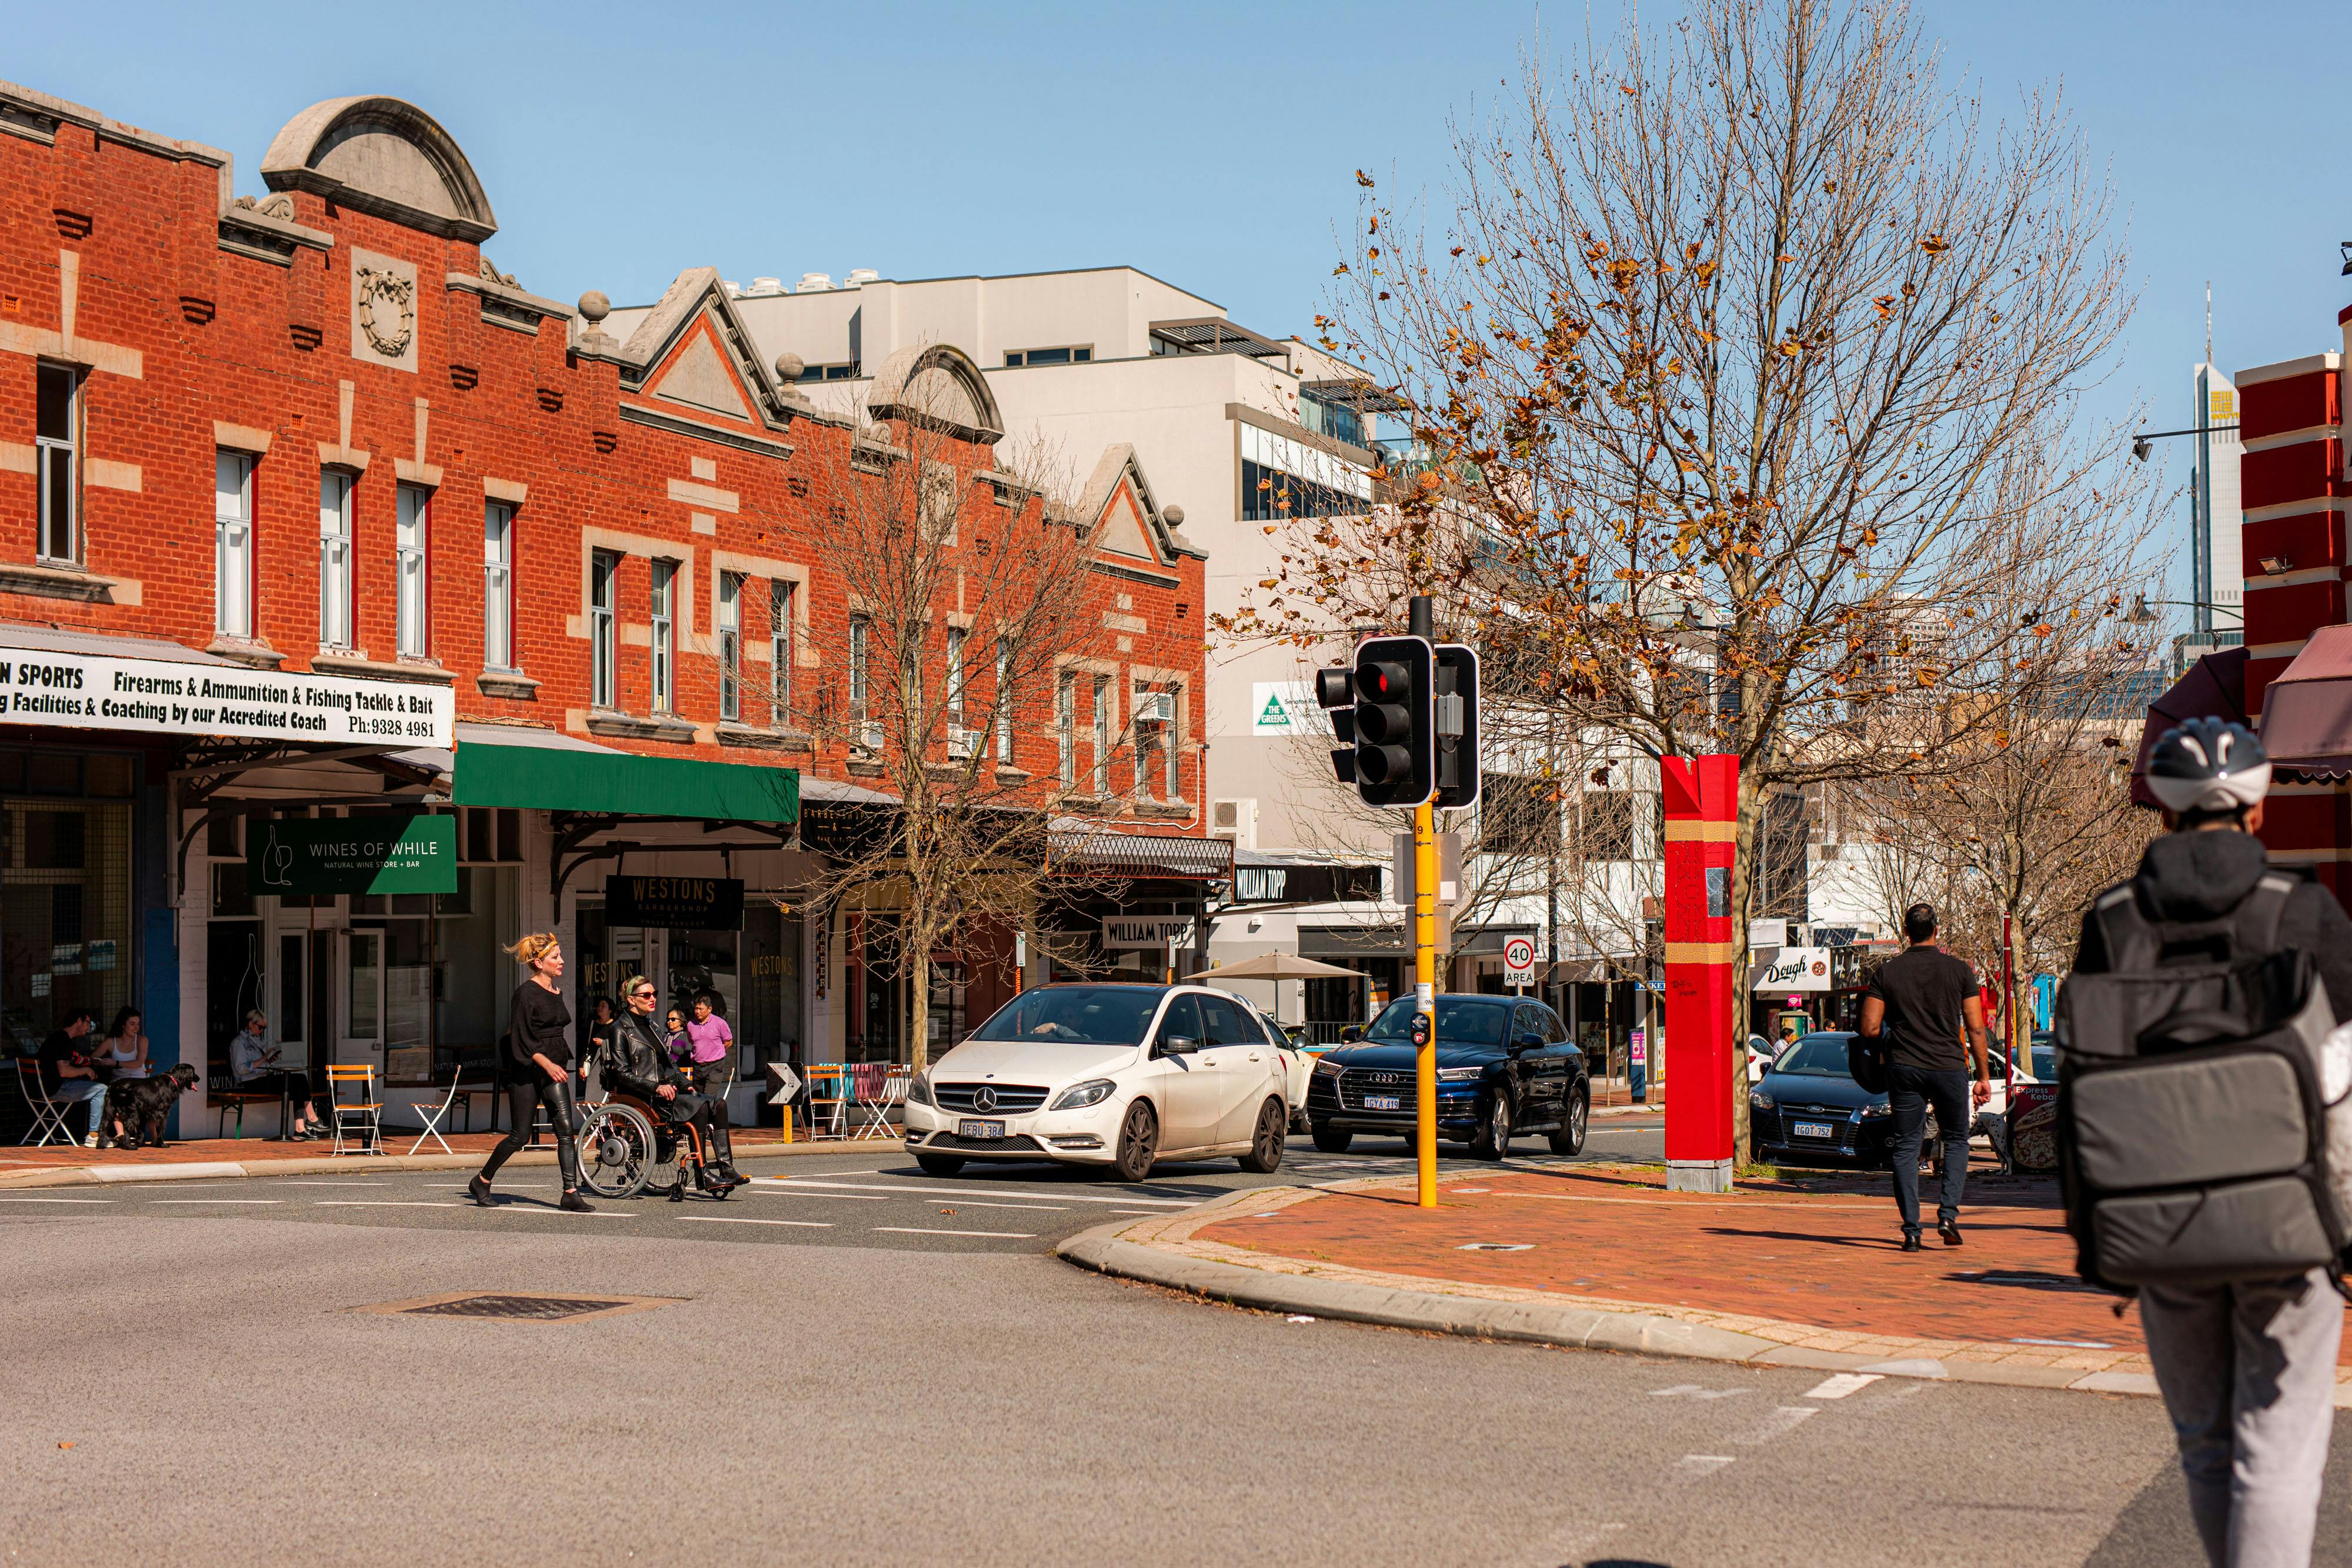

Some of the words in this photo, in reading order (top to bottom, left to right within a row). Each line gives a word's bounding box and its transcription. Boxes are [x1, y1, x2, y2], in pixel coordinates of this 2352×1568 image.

[18, 664, 83, 689] SPORTS
[114, 671, 182, 696] Firearms
[187, 677, 197, 696] &
[201, 678, 288, 704] Ammunition
[292, 686, 302, 705] &
[306, 688, 352, 712] Fishing
[355, 691, 393, 711] Tackle
[397, 695, 406, 713] &
[410, 696, 433, 714] Bait
[13, 693, 81, 714] Facilities
[85, 697, 96, 716] &
[101, 698, 167, 724] Coaching
[172, 701, 188, 724] by
[192, 707, 215, 723] our
[219, 706, 286, 728] Accredited
[290, 711, 326, 730] Coach
[1268, 706, 1280, 714] THE
[1262, 715, 1287, 724] GREENS
[406, 721, 435, 737] 4981
[833, 823, 837, 831] &
[1418, 825, 1423, 834] 9
[310, 844, 358, 857] WINES
[364, 842, 384, 856] OF
[390, 842, 437, 855] WHILE
[633, 878, 716, 903] WESTONS
[1237, 869, 1266, 900] WILLIAM
[1267, 870, 1286, 899] TOPP
[638, 904, 709, 912] BARBERSHOP
[1108, 922, 1155, 941] WILLIAM
[1158, 922, 1188, 941] TOPP
[1509, 948, 1529, 961] 40
[751, 955, 792, 977] WESTONS
[1765, 955, 1807, 983] Dough
[584, 962, 633, 987] WESTONS
[1506, 973, 1533, 982] AREA
[2016, 1086, 2049, 1094] Express
